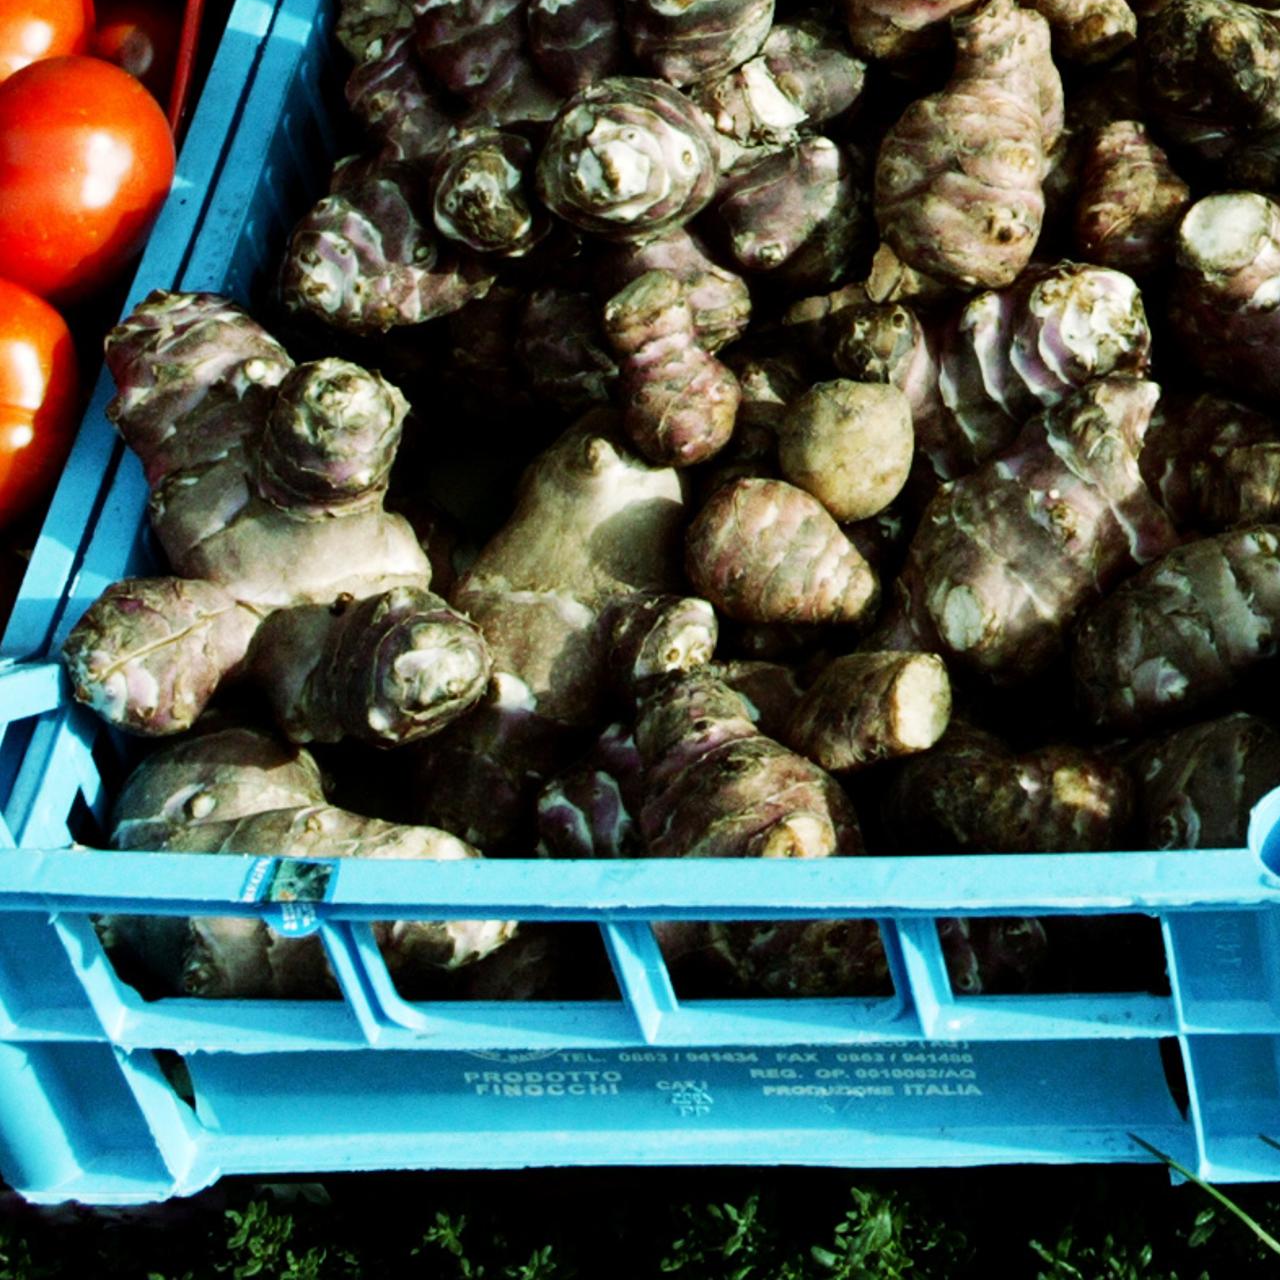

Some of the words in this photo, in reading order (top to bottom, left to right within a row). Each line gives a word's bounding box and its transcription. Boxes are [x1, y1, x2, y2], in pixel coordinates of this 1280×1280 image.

[776, 1051, 819, 1063] FAX
[464, 1071, 623, 1084] PRODOTTO
[475, 1083, 619, 1097] FINOCCHI
[903, 1083, 983, 1097] ITALIA
